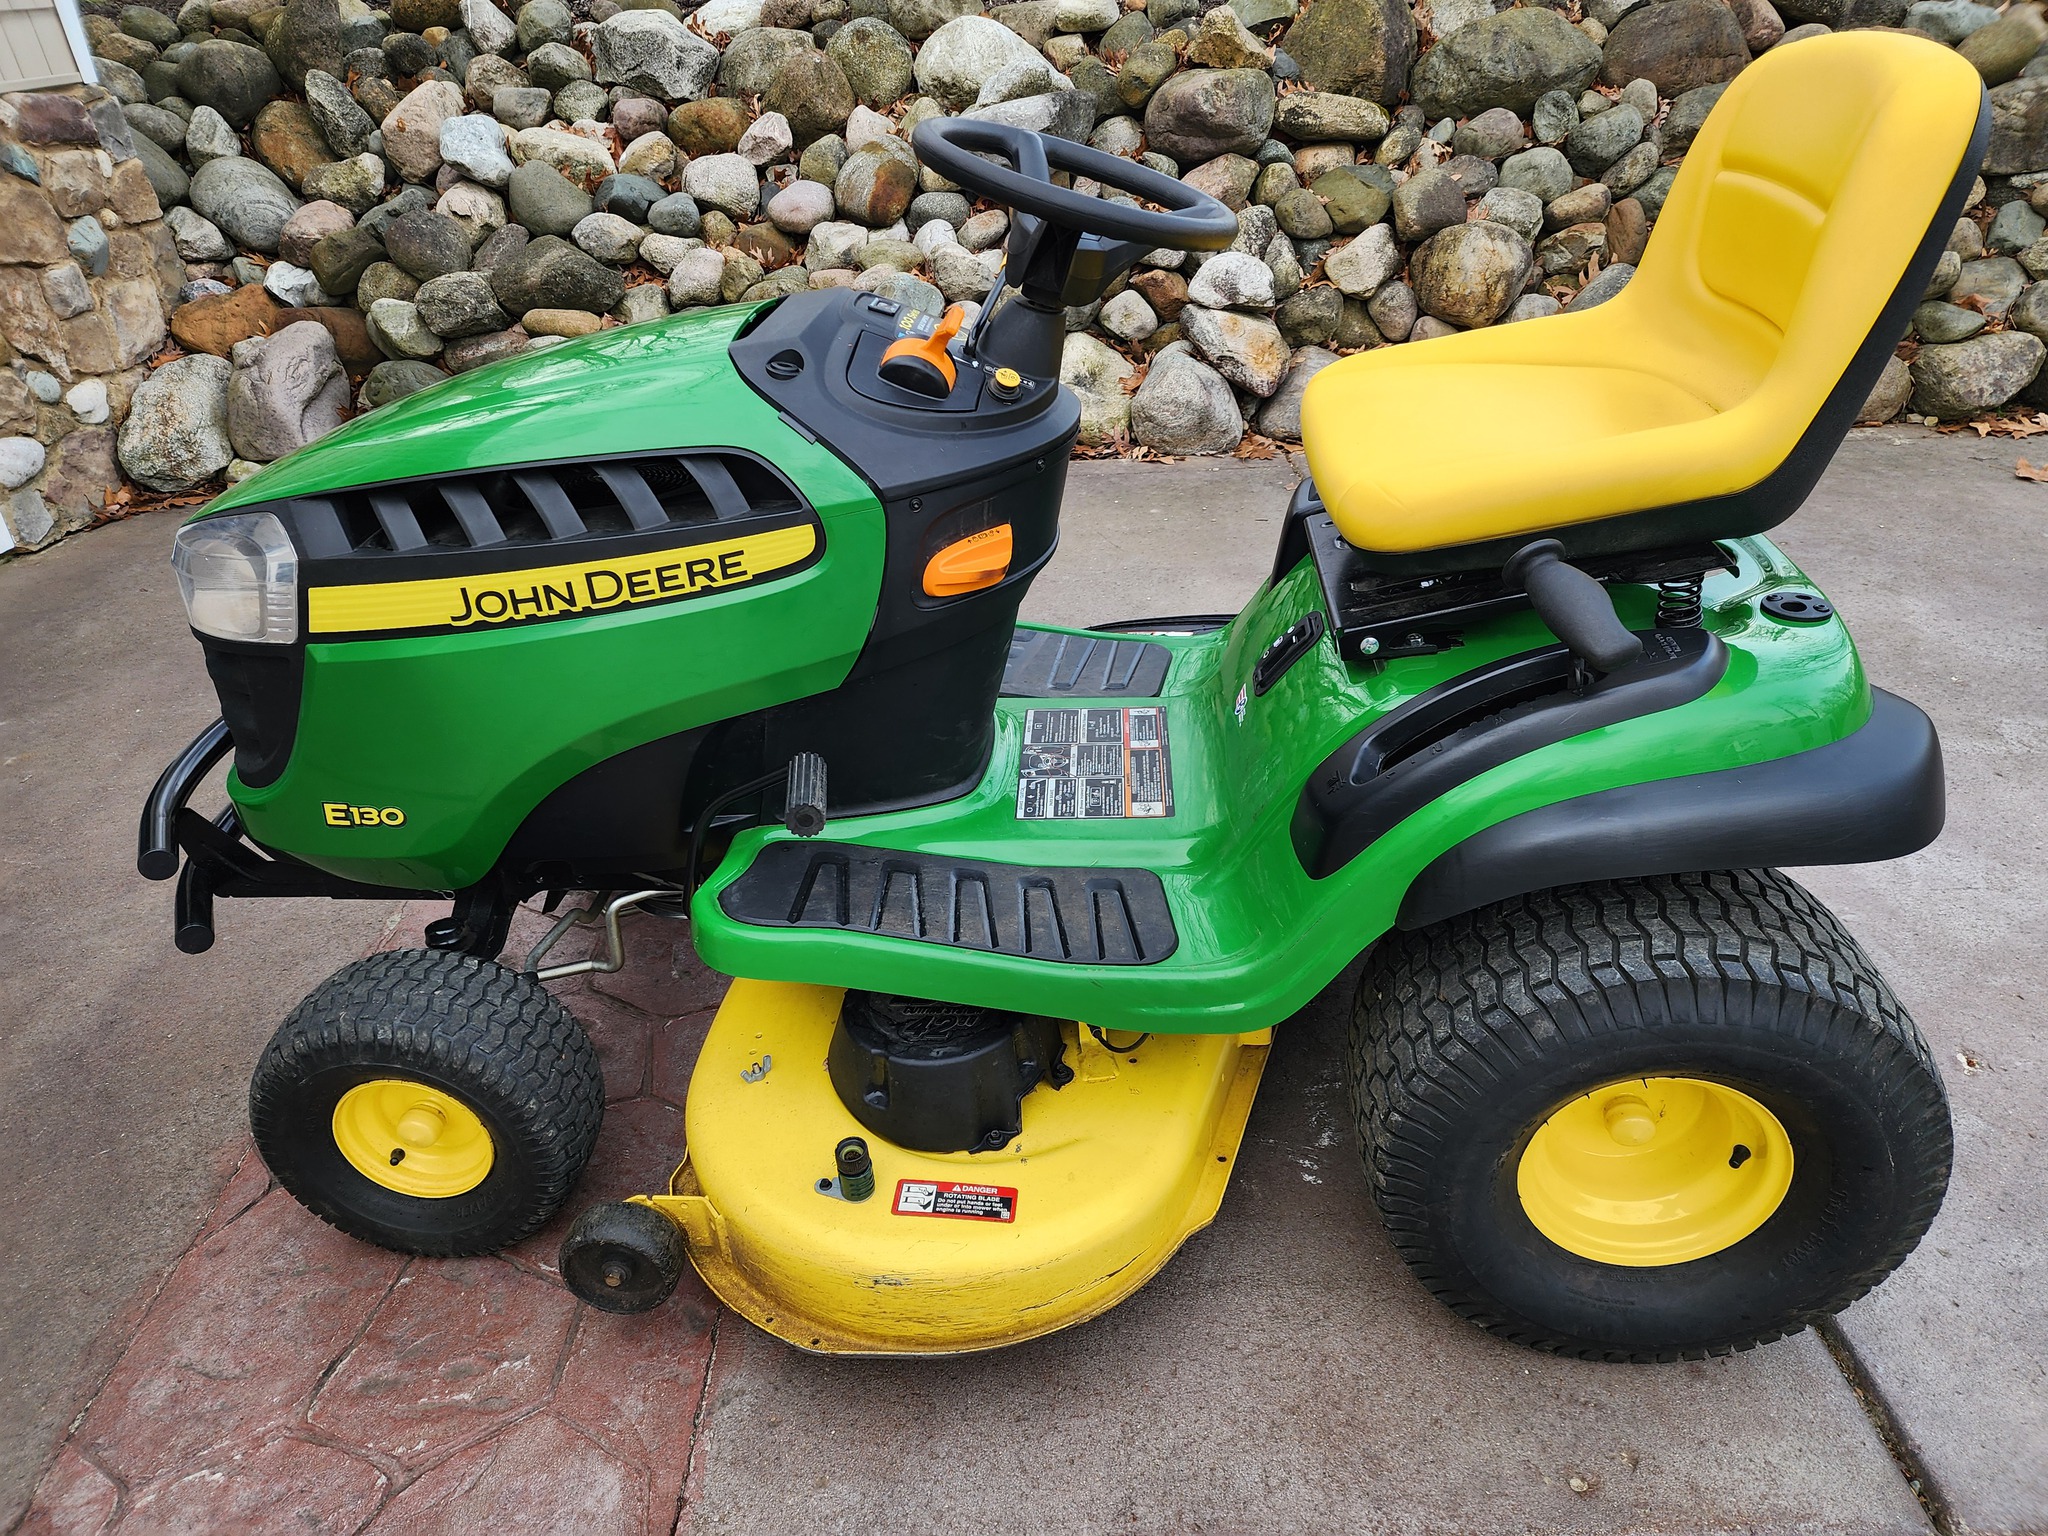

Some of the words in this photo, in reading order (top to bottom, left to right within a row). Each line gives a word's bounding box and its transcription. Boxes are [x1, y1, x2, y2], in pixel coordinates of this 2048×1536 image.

[899, 316, 914, 330] 100
[450, 581, 577, 623] JOHN
[585, 551, 749, 603] DEERE
[322, 802, 405, 827] E130
[962, 1186, 997, 1194] DANGER
